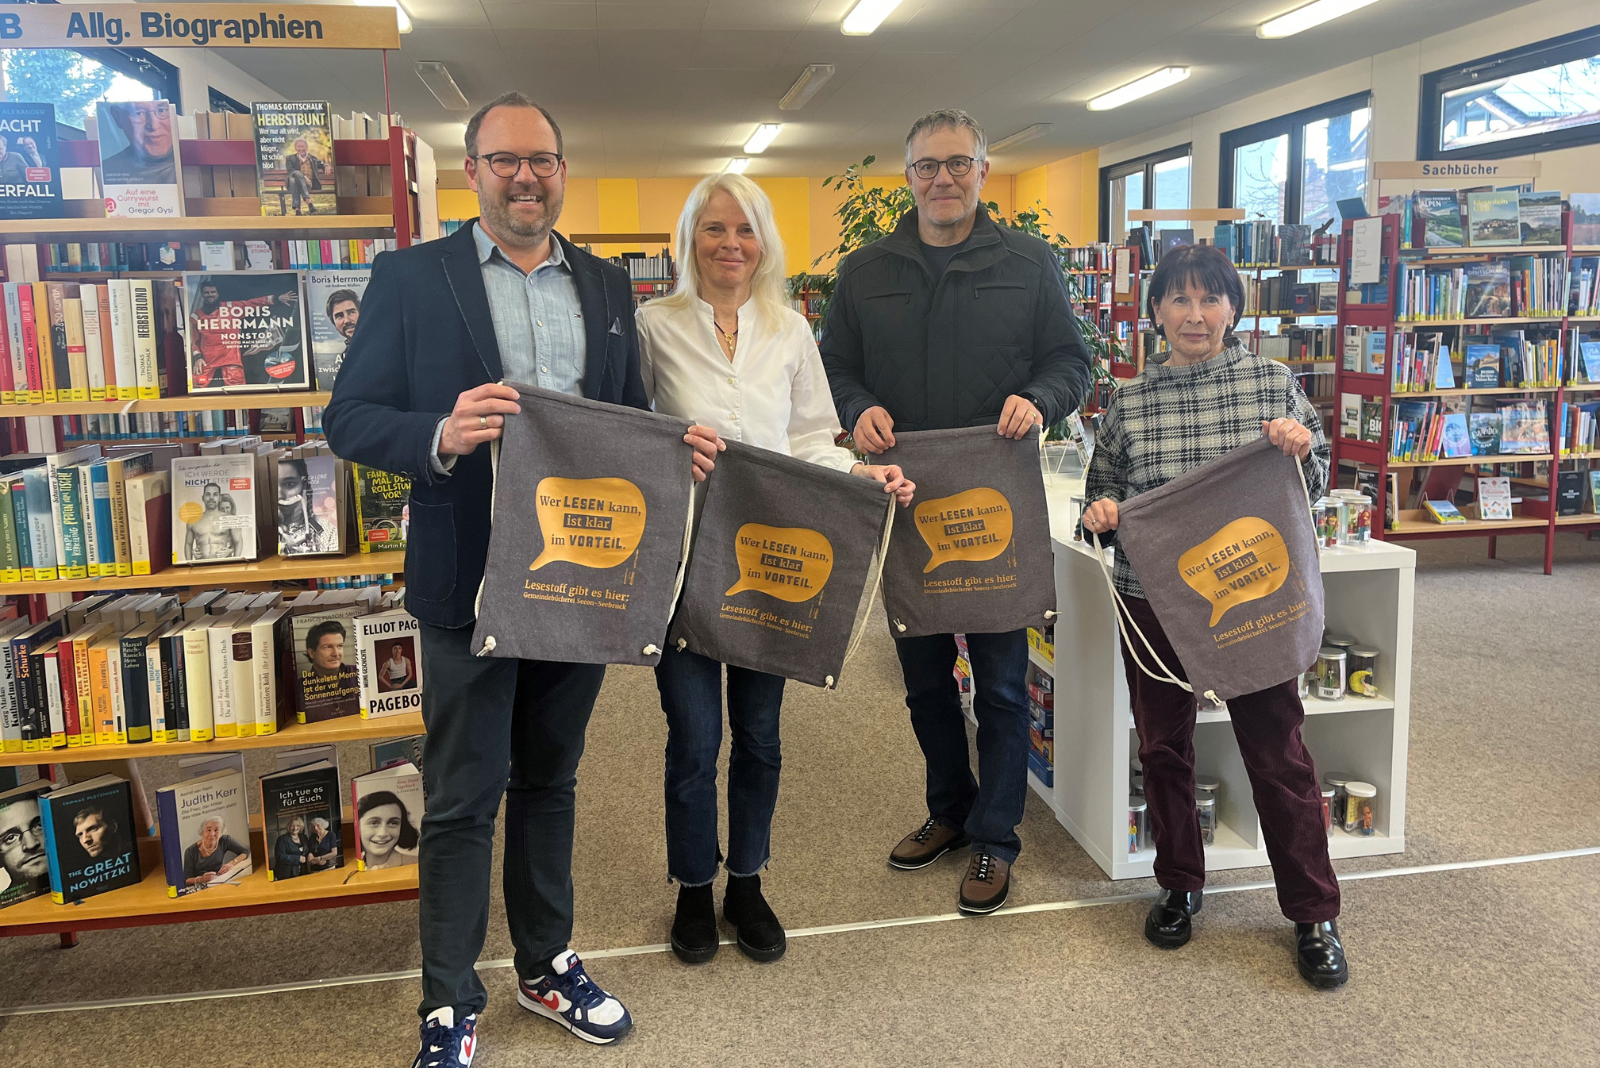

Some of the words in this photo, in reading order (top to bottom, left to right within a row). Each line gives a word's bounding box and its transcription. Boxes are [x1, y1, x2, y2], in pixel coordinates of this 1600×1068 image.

[1, 13, 23, 40] B
[66, 12, 130, 45] Allg.
[141, 12, 323, 45] Biographien
[0, 120, 41, 132] ACHT
[257, 113, 325, 126] HERBSTBUNT
[1422, 164, 1498, 176] Sachbücher
[0, 184, 55, 197] ERFALL
[135, 288, 150, 338] HERBSTBLOND
[219, 305, 271, 318] BORIS
[55, 313, 64, 332] 2850
[197, 317, 294, 331] HERRMANN
[372, 477, 392, 486] MAL
[50, 481, 59, 503] Schwere
[62, 504, 78, 525] PFOTEN
[540, 495, 561, 507] Wer
[564, 496, 604, 511] LESEN
[608, 502, 642, 516] kann,
[919, 515, 938, 525] Wer
[940, 508, 974, 521] LESEN
[977, 504, 1007, 516] kann,
[117, 497, 125, 540] AFRIKANISCHES
[567, 515, 582, 527] ist
[585, 518, 610, 529] klar
[946, 525, 959, 535] ist
[962, 521, 983, 532] klar
[36, 534, 44, 565] WOLFGANG
[70, 527, 82, 556] KERKELING
[551, 534, 565, 545] im
[570, 535, 626, 550] VORTEIL.
[741, 536, 760, 548] Wer
[762, 540, 798, 555] LESEN
[800, 548, 829, 563] kann,
[937, 542, 951, 551] im
[953, 533, 1002, 548] VORTEIL.
[764, 555, 776, 566] ist
[780, 560, 800, 570] klar
[1185, 562, 1206, 577] Wer
[1205, 543, 1241, 567] LESEN
[1242, 530, 1275, 548] kann,
[1218, 566, 1233, 579] ist
[1233, 555, 1255, 571] klar
[747, 568, 760, 579] im
[765, 571, 813, 589] VORTEIL.
[923, 577, 962, 588] Lesestoff
[965, 577, 982, 586] gibt
[996, 574, 1017, 583] hier:
[1214, 588, 1230, 600] im
[1229, 562, 1281, 590] VORTEIL.
[523, 591, 575, 603] Gemeindebücherei
[525, 579, 567, 594] Lesestoff
[568, 586, 588, 597] gibt
[591, 589, 602, 598] es
[605, 589, 630, 602] hier:
[363, 622, 396, 635] ELLIOT
[399, 619, 418, 631] PAG
[721, 603, 759, 616] Lesestoff
[760, 611, 778, 622] gibt
[780, 617, 790, 626] es
[791, 619, 813, 633] hier:
[1213, 621, 1254, 642] Lesestoff
[1256, 614, 1276, 628] gibt
[1276, 610, 1288, 619] es
[3, 646, 12, 679] Schratt
[20, 644, 29, 679] Schurke
[302, 670, 314, 678] Der
[303, 674, 337, 685] dunkelste
[304, 687, 359, 700] Sonnenaufgang
[314, 684, 326, 692] der
[8, 681, 19, 728] Katharina
[225, 709, 230, 717] Du
[181, 793, 214, 808] Judith
[216, 788, 238, 799] Kerr
[280, 791, 293, 799] Ich
[299, 794, 322, 803] Euch
[68, 870, 82, 878] THE
[84, 852, 131, 877] GREAT
[70, 865, 130, 893] NOWITZKI
